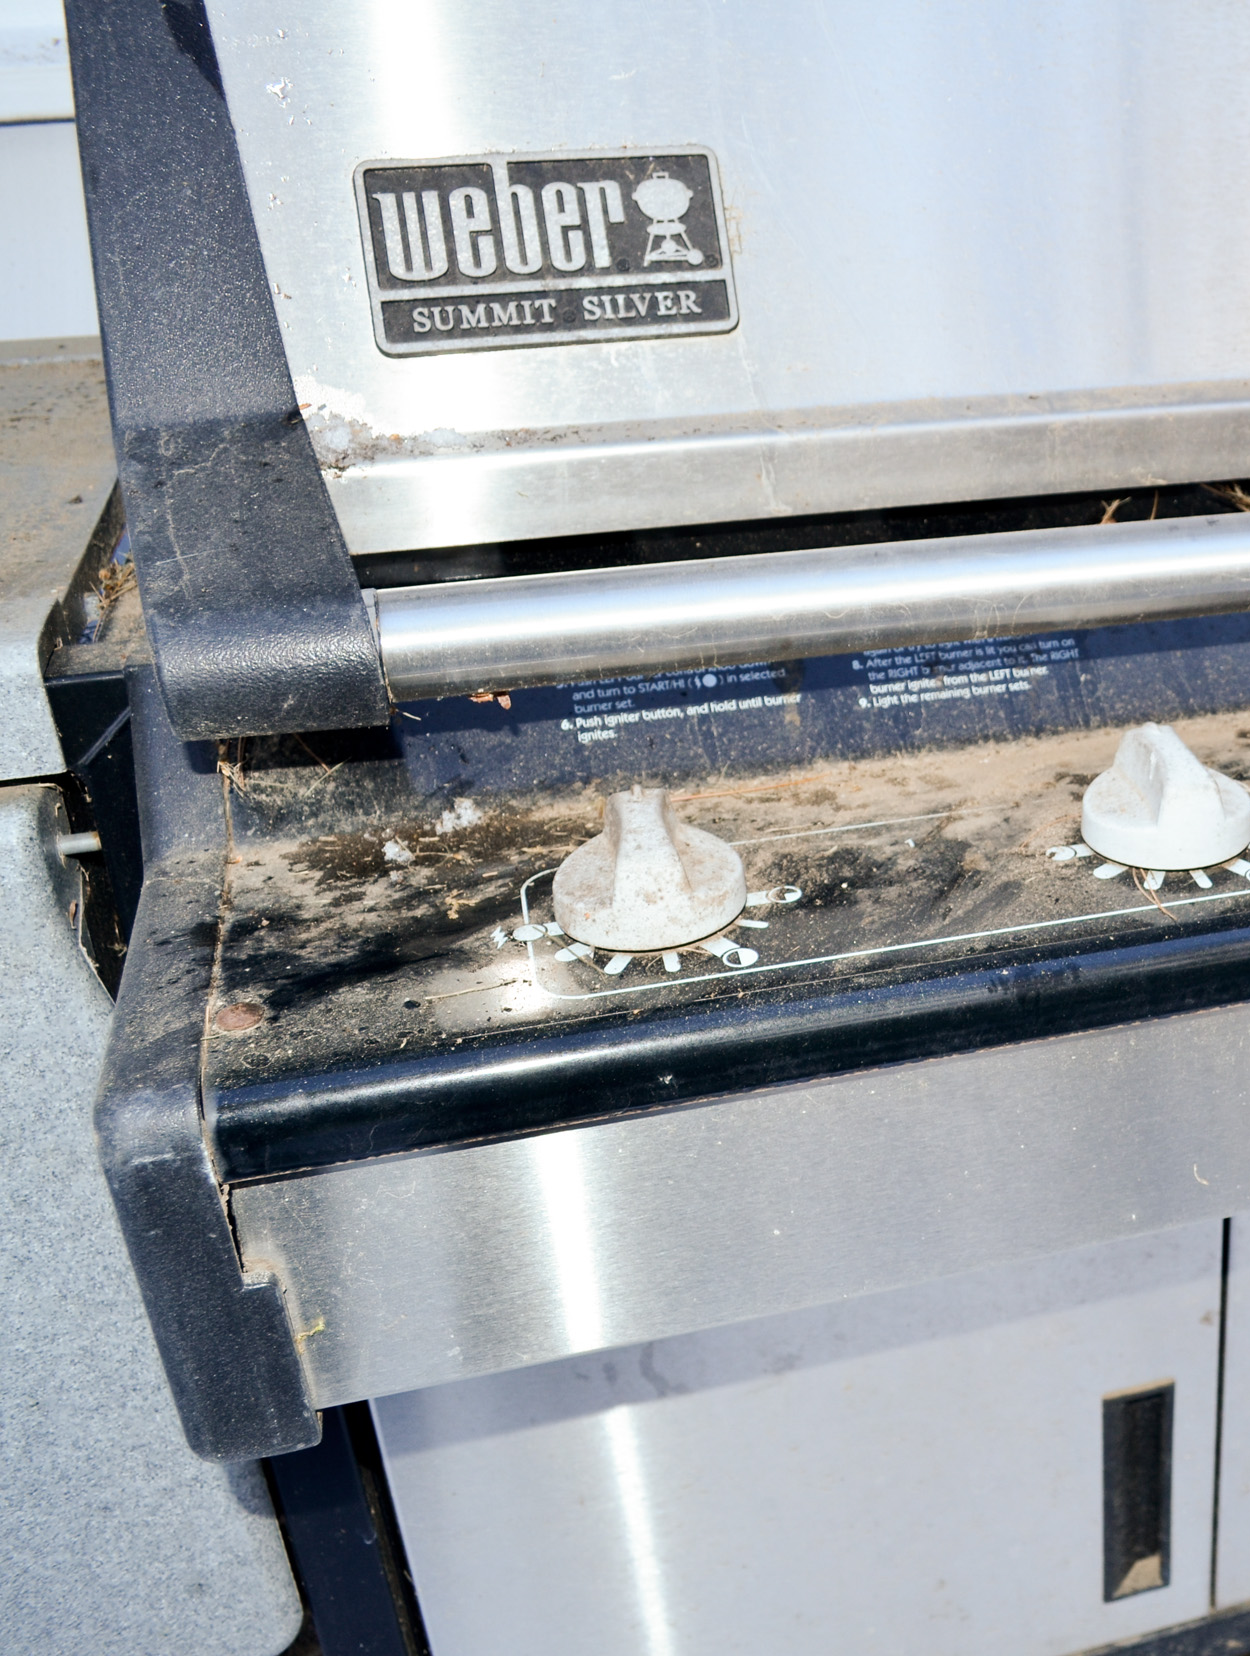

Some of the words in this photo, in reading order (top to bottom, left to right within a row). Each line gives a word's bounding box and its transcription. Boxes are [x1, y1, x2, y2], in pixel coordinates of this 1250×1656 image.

[371, 158, 625, 281] weber
[412, 298, 557, 334] SUMMIT
[582, 289, 702, 322] SILVER
[866, 658, 892, 668] After
[894, 656, 912, 665] the
[938, 648, 973, 660] burner
[975, 647, 984, 656] is
[985, 646, 997, 655] lit
[998, 645, 1017, 654] you
[1038, 639, 1059, 649] turn
[1061, 638, 1076, 647] on
[868, 672, 886, 681] the
[888, 666, 918, 678] RIGHT
[958, 657, 1001, 672] adjacent
[1004, 657, 1016, 666] to
[1050, 648, 1079, 660] RIGHT
[572, 689, 595, 701] and
[597, 687, 620, 698] turn
[622, 685, 636, 695] to
[638, 677, 685, 693] START/HI
[726, 672, 738, 683] in
[739, 668, 786, 681] selected
[858, 697, 872, 709] 9.
[873, 695, 900, 709] Light
[900, 693, 919, 704] the
[920, 687, 971, 702] remaining
[971, 683, 1007, 696] burner
[1008, 680, 1032, 692] sets.
[869, 682, 906, 695] burner
[943, 674, 969, 686] from
[969, 672, 988, 683] the
[988, 668, 1011, 681] LEFT
[561, 719, 574, 731] 6.
[576, 715, 602, 728] Push
[604, 712, 640, 727] igniter
[642, 706, 684, 721] button,
[686, 703, 709, 716] and
[710, 700, 737, 713] hold
[739, 696, 762, 710] until
[763, 694, 802, 706] burner
[574, 700, 613, 714] burner
[615, 699, 636, 709] set.
[577, 728, 618, 744] ignites.
